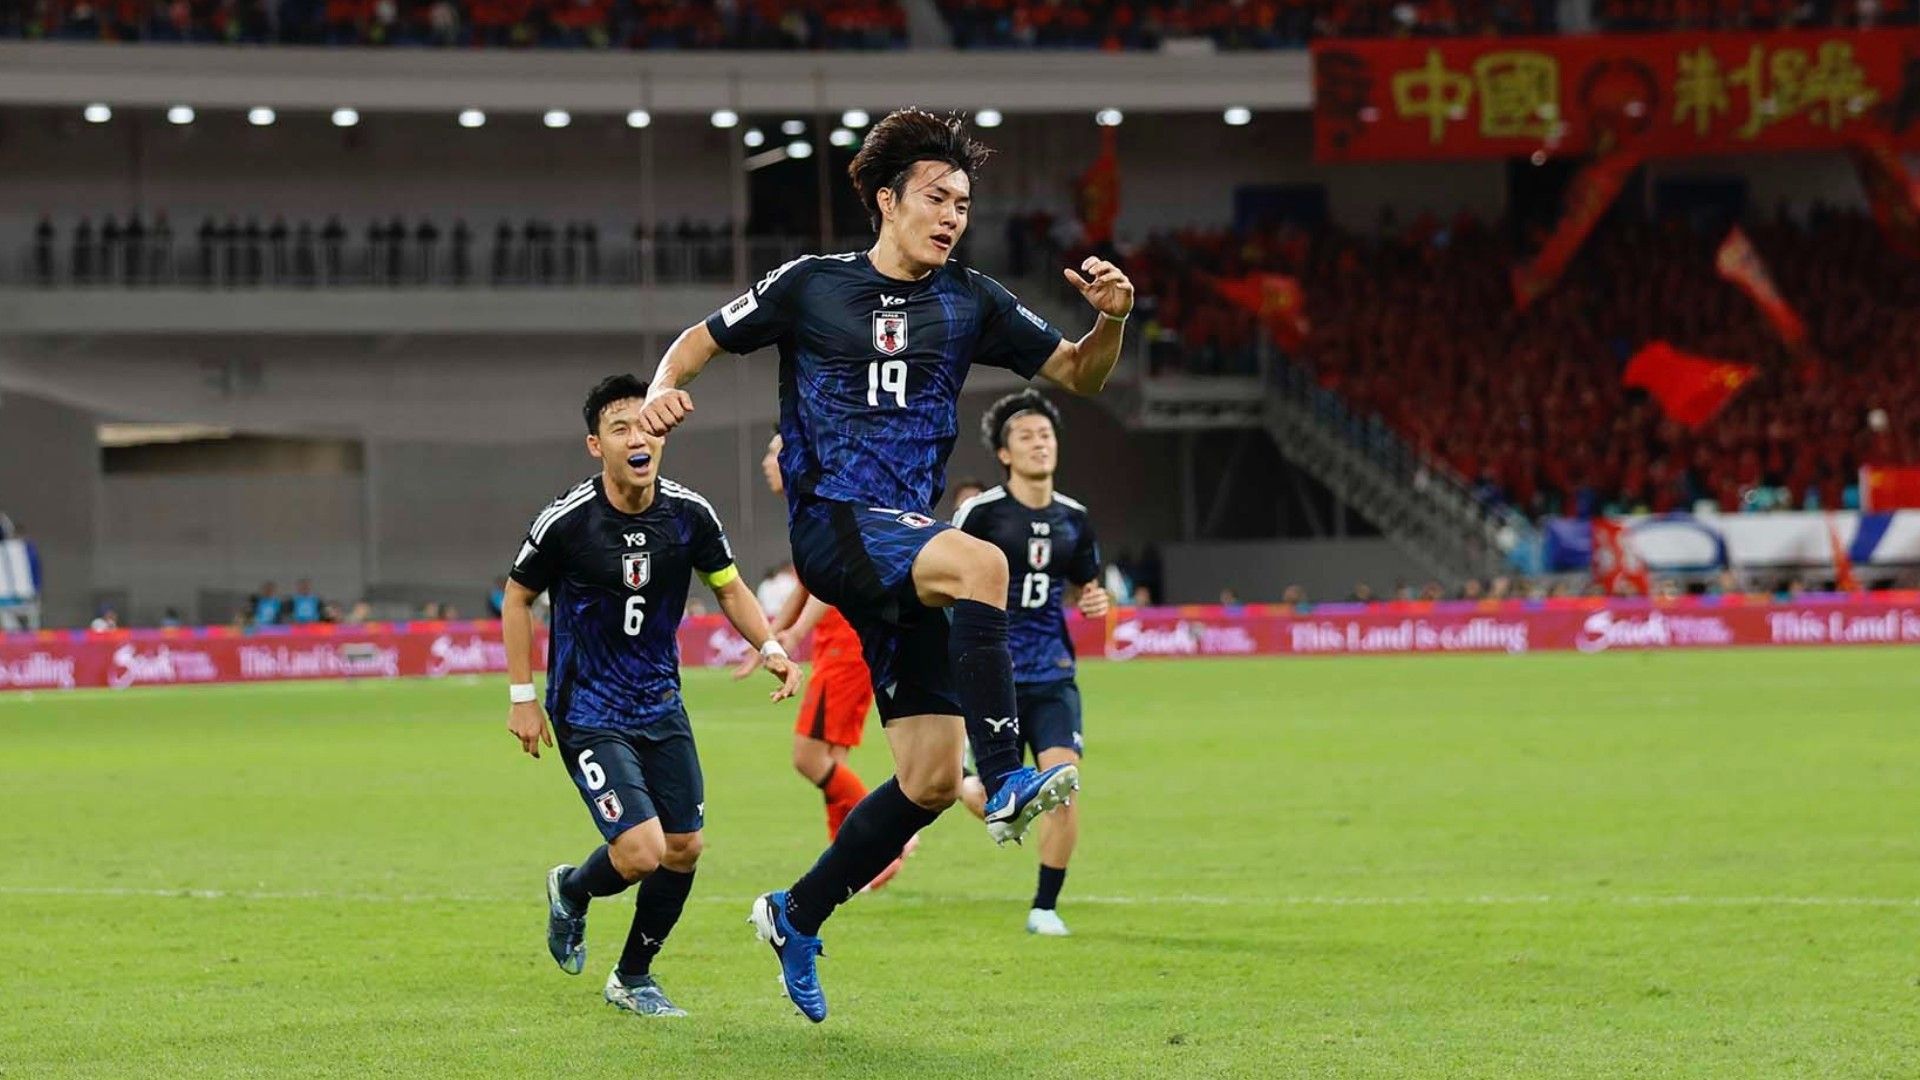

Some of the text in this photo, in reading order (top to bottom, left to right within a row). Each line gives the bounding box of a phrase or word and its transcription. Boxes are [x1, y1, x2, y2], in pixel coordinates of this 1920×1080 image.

[867, 360, 908, 408] 19
[623, 532, 647, 547] Y-3
[1021, 572, 1050, 608] 13
[623, 594, 646, 636] 6
[578, 748, 606, 791] 6
